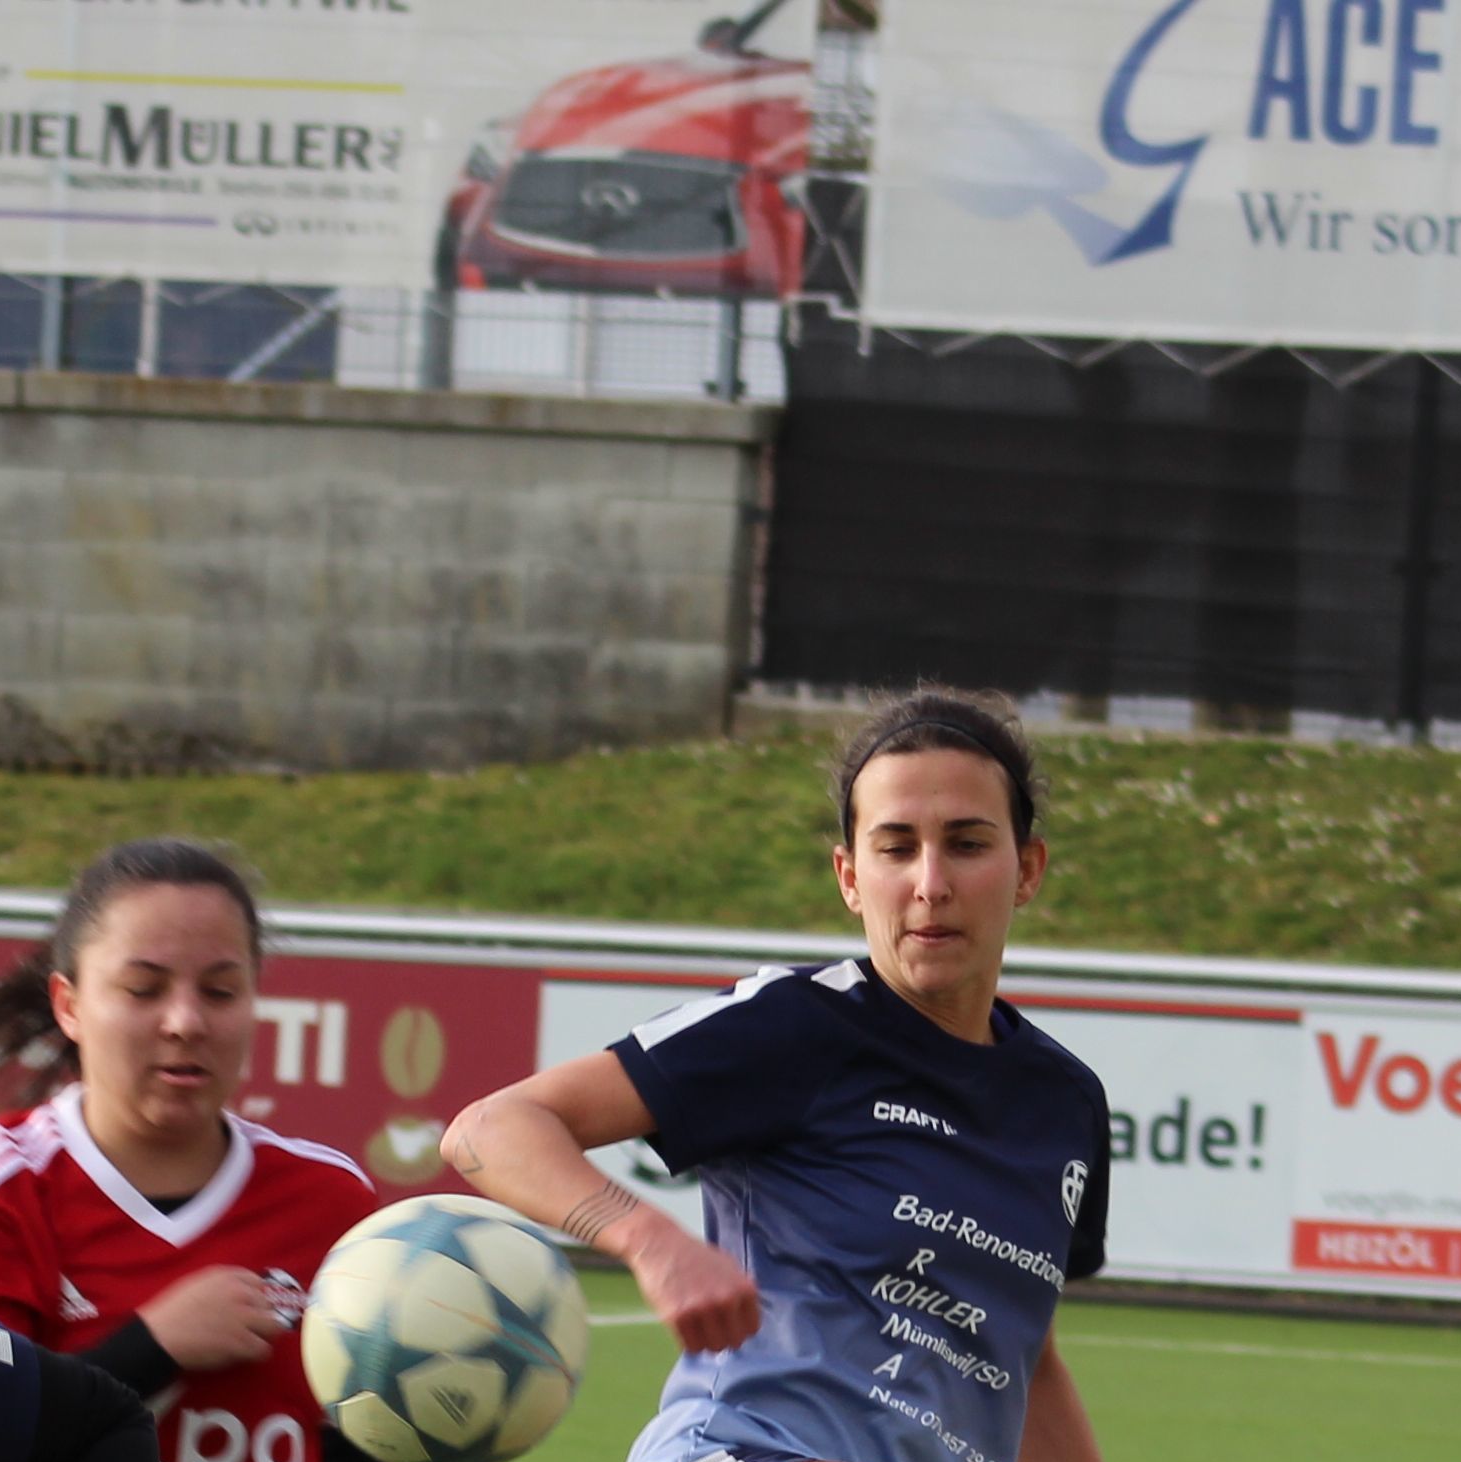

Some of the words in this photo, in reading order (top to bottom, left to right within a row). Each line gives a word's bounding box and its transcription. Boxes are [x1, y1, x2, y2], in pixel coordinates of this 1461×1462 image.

[1248, 0, 1442, 146] ACE
[1236, 191, 1354, 257] Wir
[873, 1101, 939, 1132] CRAFT
[908, 1249, 935, 1275] R
[1318, 1228, 1436, 1270] HEIZÖL
[872, 1274, 987, 1335] KOHLER
[873, 1353, 903, 1380] A
[869, 1385, 919, 1419] Natel
